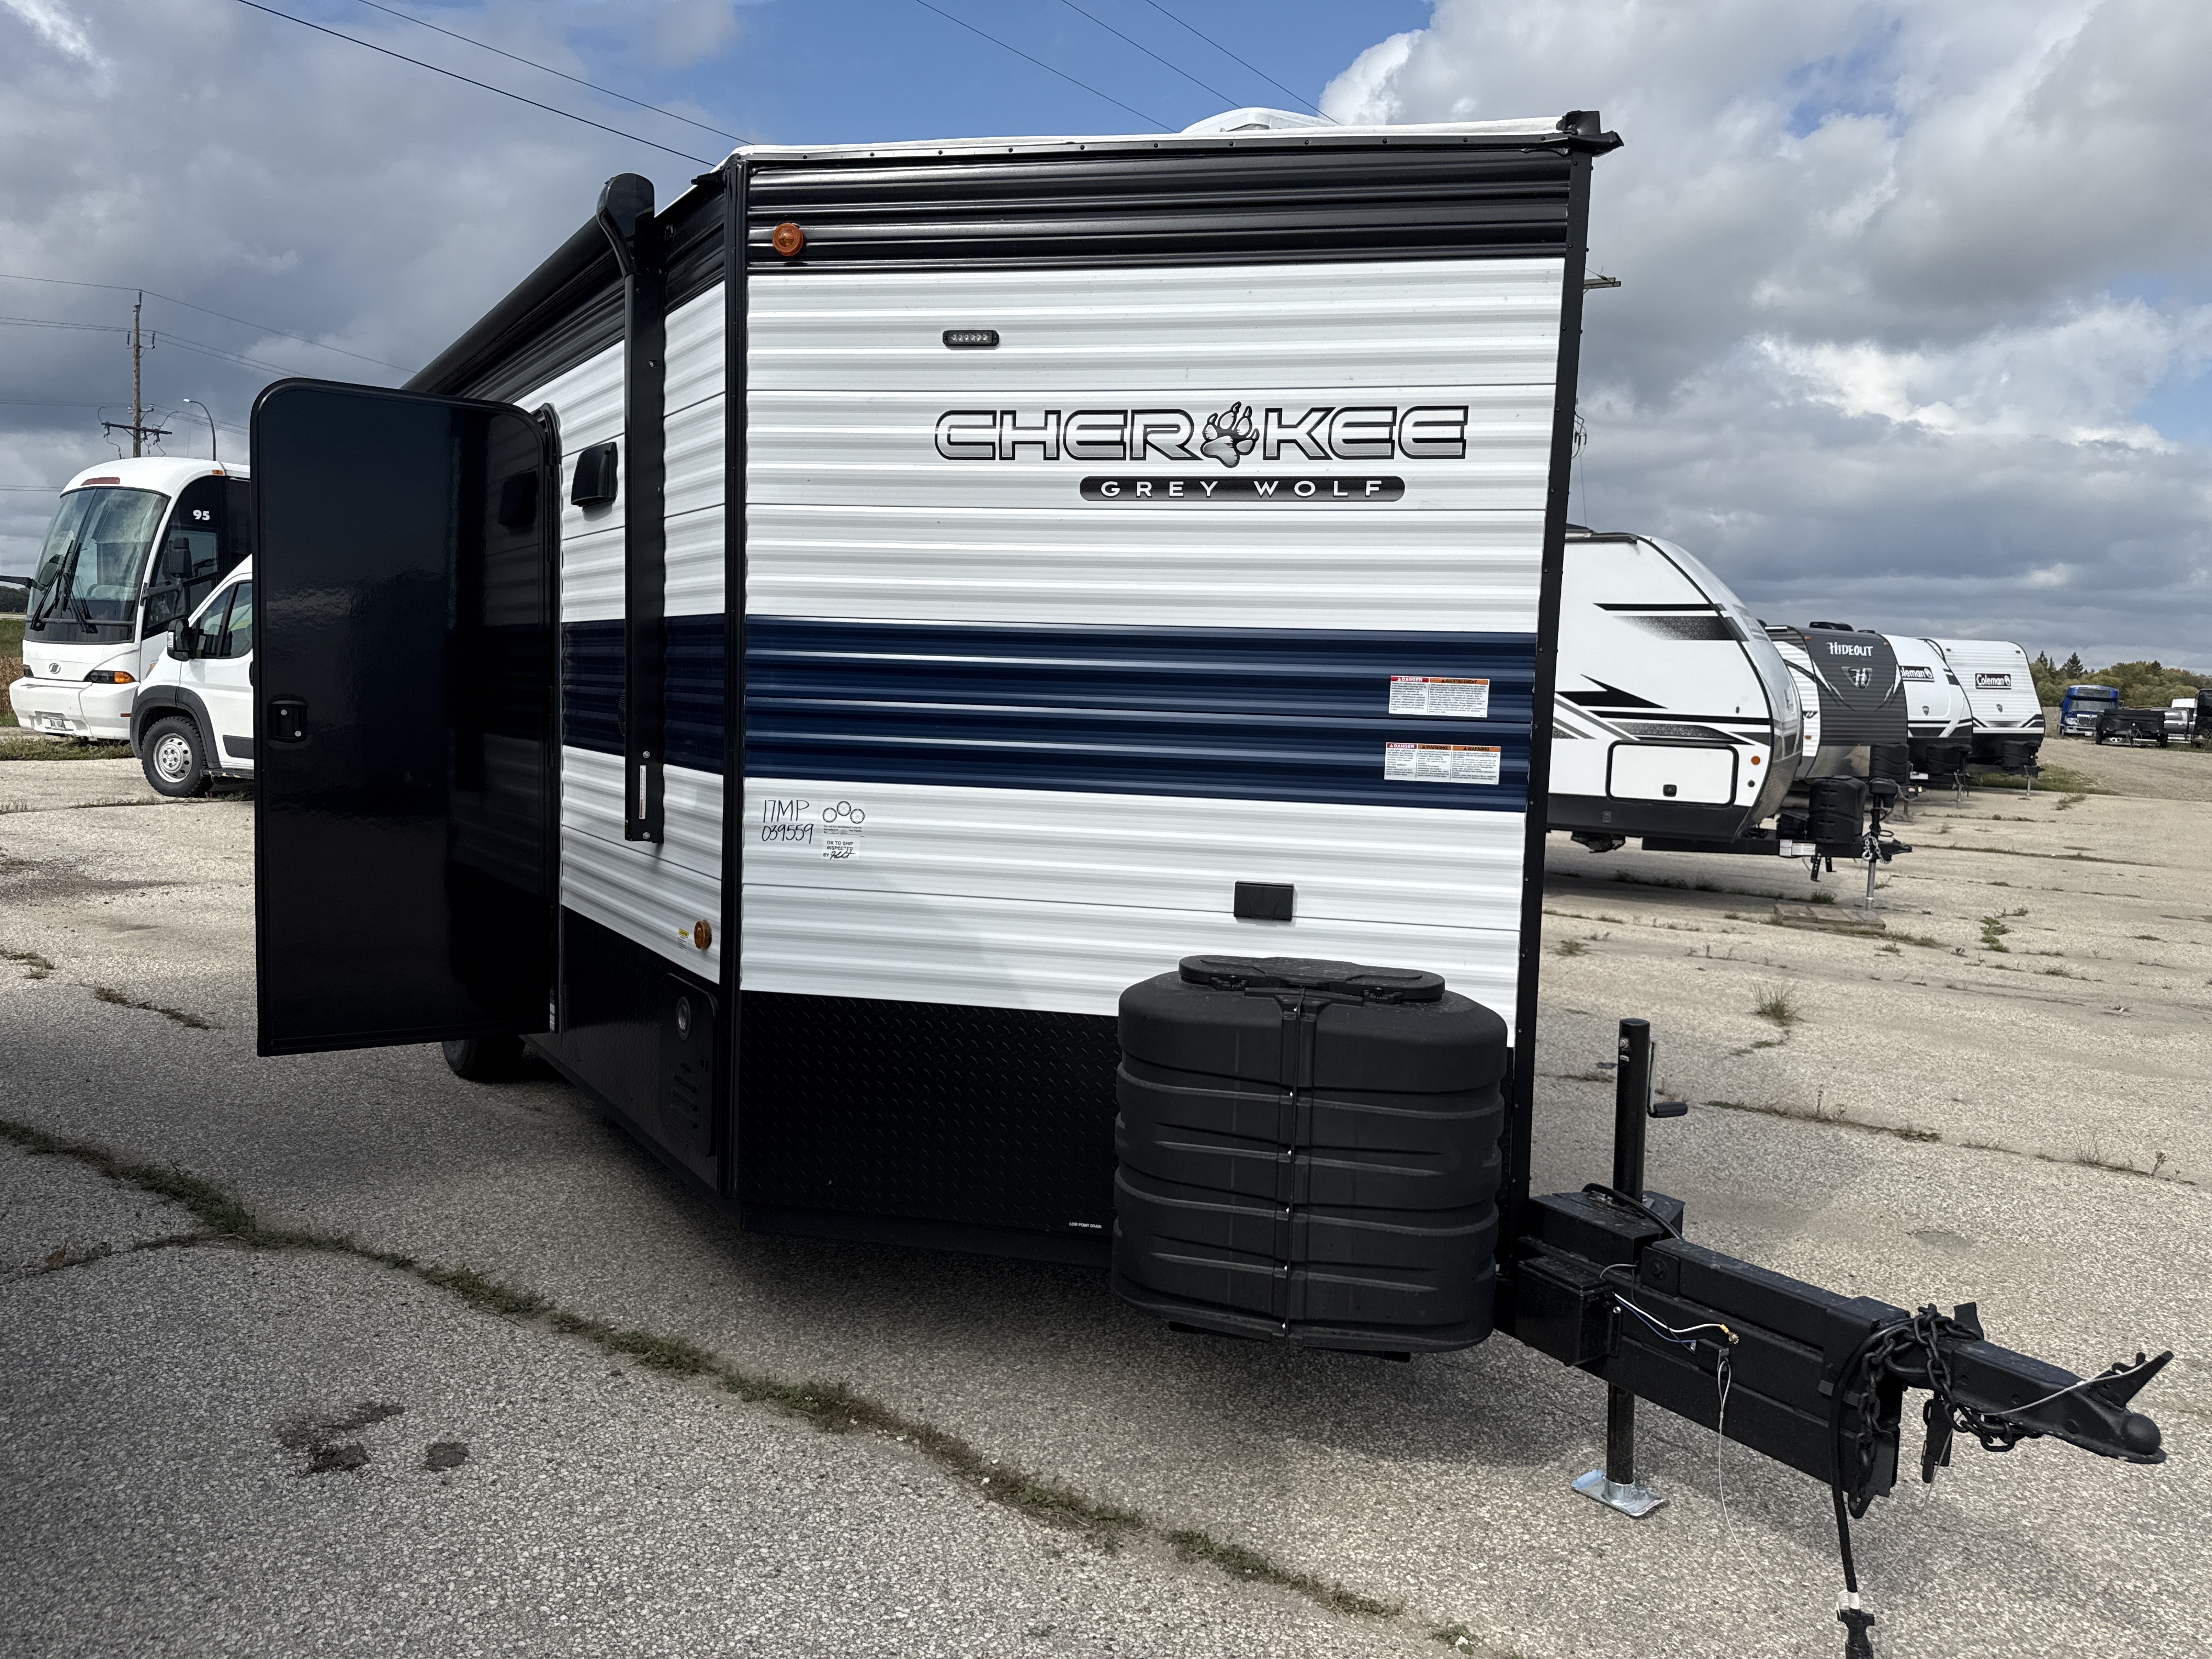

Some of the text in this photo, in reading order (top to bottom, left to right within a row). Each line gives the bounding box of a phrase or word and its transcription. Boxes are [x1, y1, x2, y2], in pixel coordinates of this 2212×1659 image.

[1101, 479, 1382, 498] GREY WOLF
[193, 509, 210, 521] 95
[1826, 641, 1874, 657] HIDEOUT
[1976, 674, 2004, 686] Coleman
[762, 823, 814, 845] 039559
